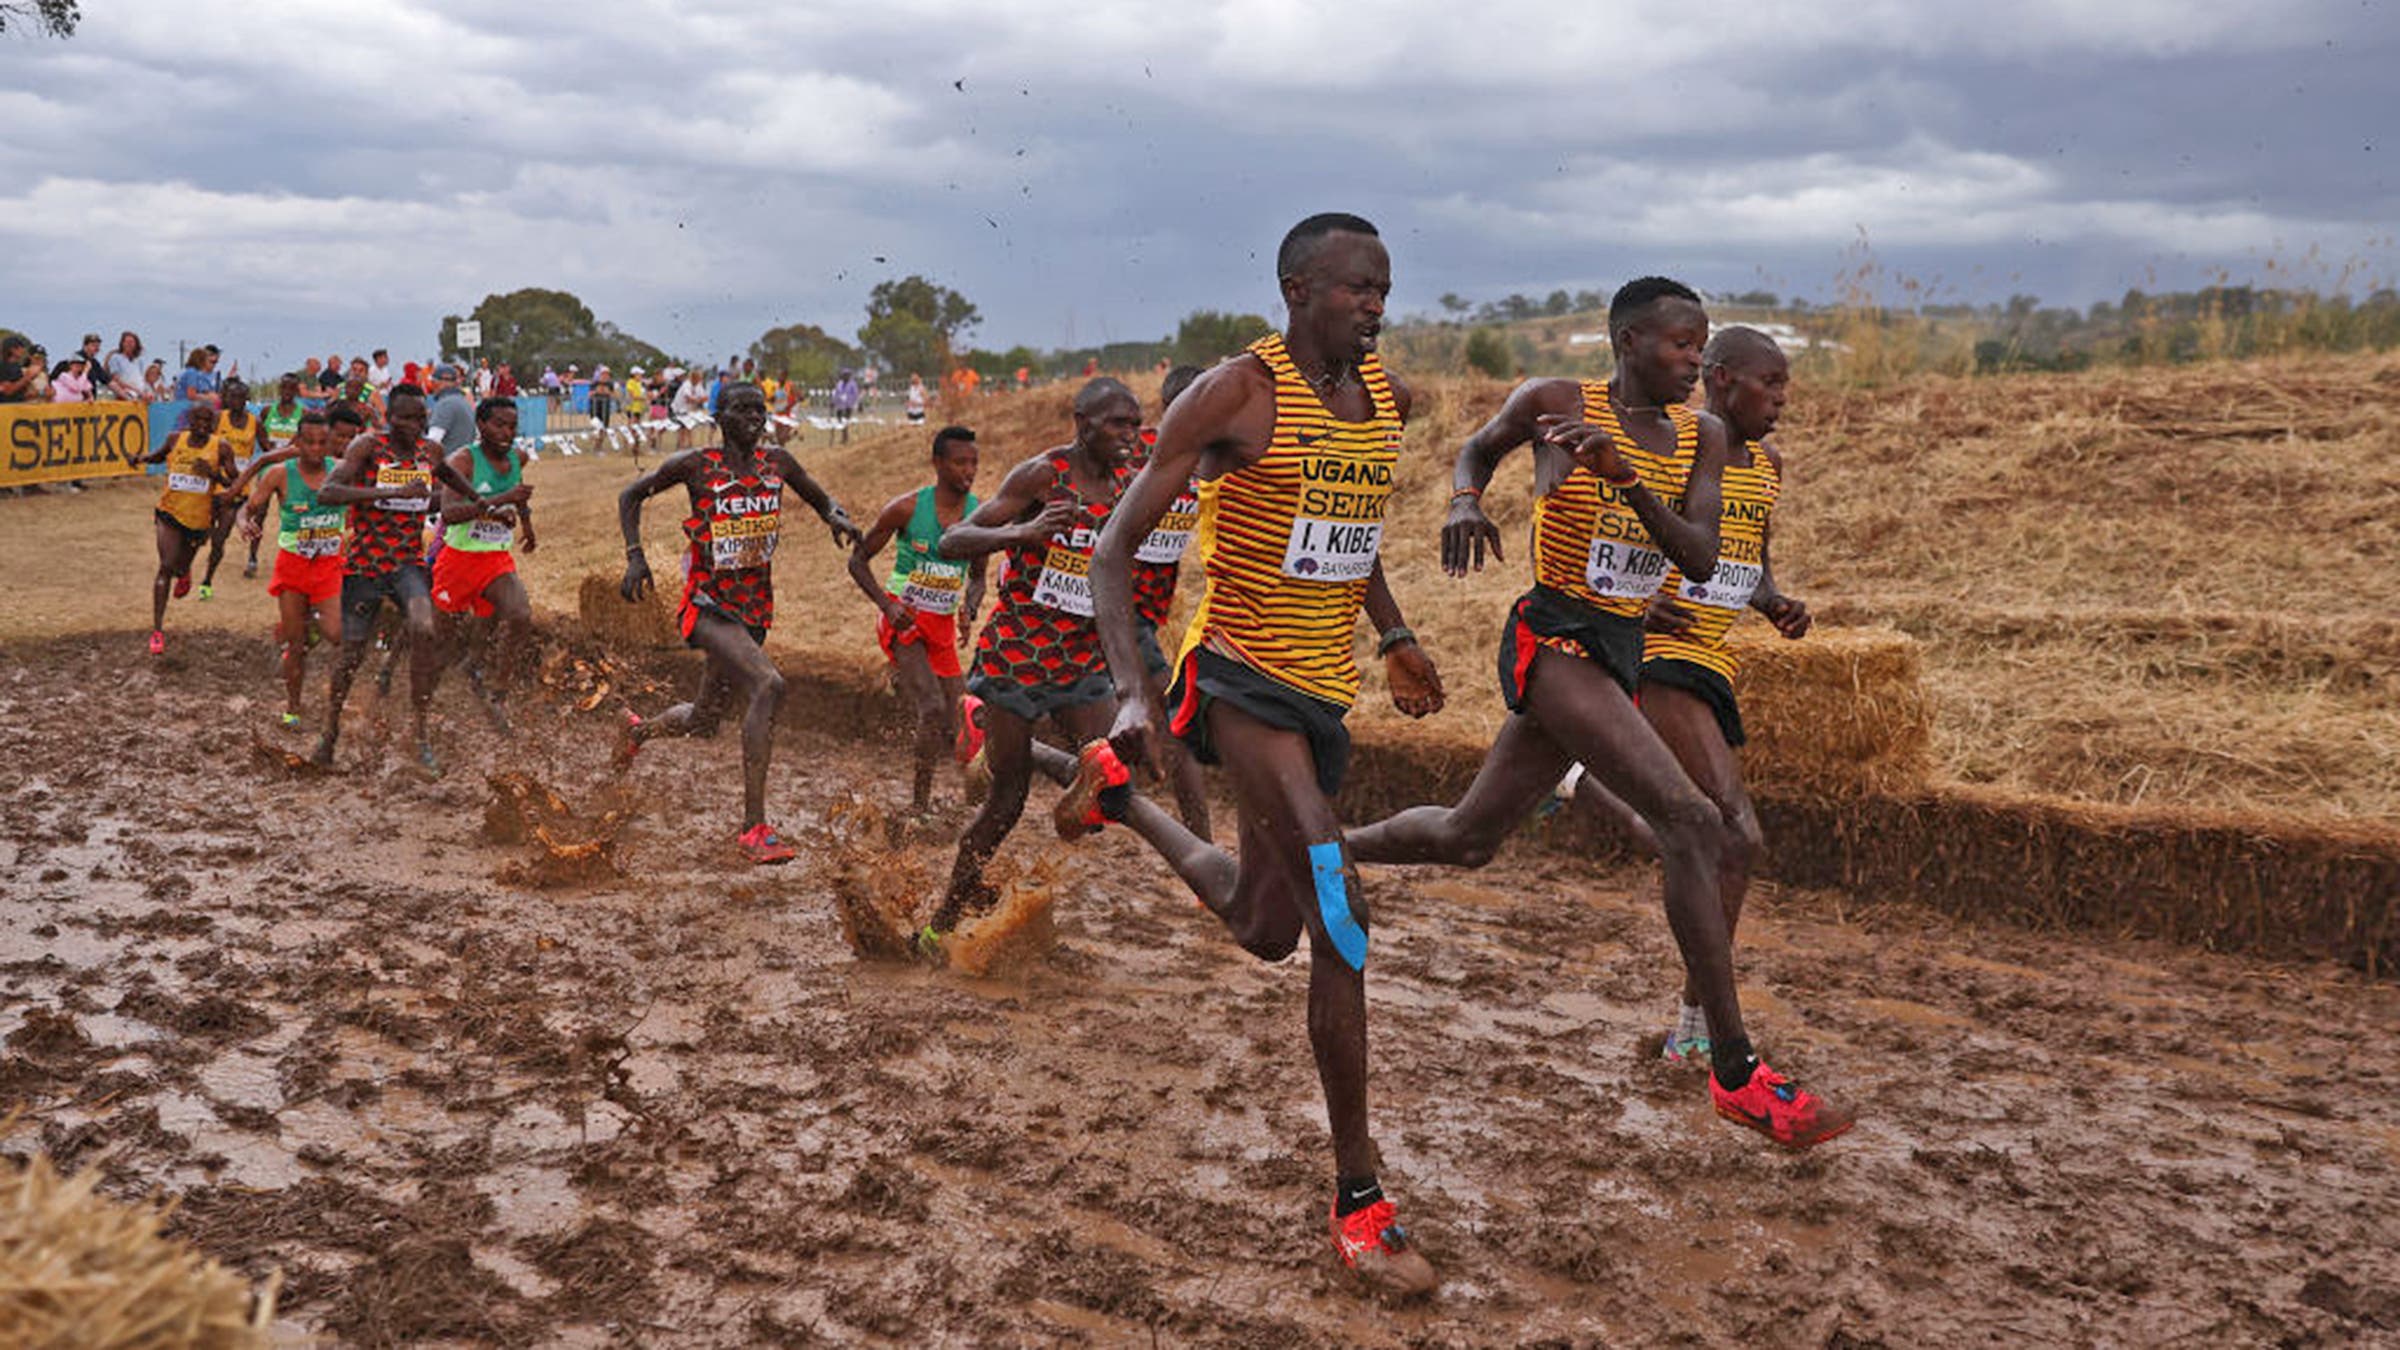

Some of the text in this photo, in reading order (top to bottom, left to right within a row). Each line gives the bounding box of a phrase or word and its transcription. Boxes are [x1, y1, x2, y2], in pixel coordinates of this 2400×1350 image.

[10, 413, 145, 470] SEIKO
[715, 493, 779, 514] KENYA
[713, 517, 778, 537] SEIKO
[1302, 522, 1316, 551] I.
[1597, 543, 1617, 571] R.
